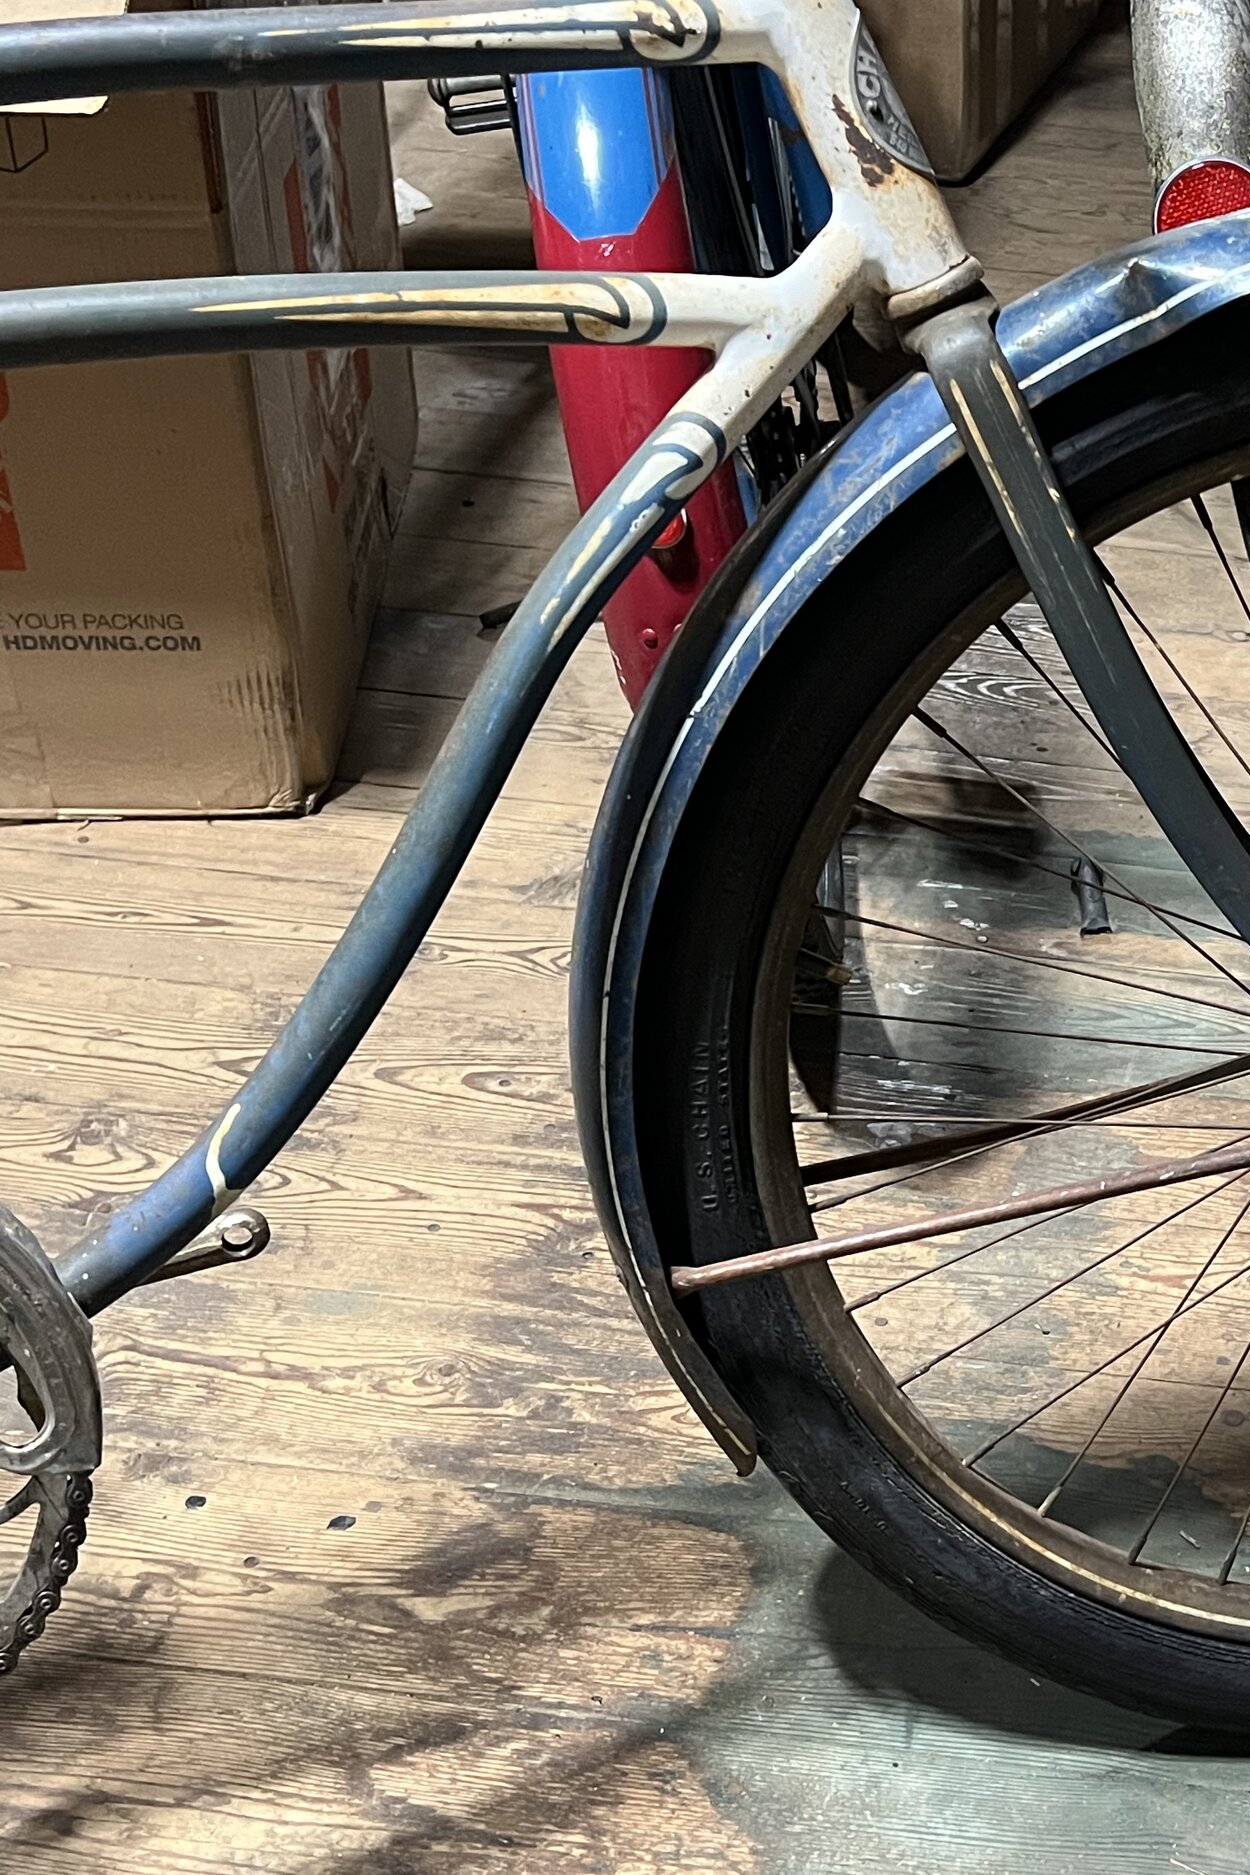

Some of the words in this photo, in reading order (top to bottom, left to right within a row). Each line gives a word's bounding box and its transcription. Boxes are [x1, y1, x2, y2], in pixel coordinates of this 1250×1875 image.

[7, 612, 77, 630] YOUR
[83, 613, 185, 630] PACKING
[2, 634, 203, 652] HDMOVING.COM
[690, 1042, 711, 1138] CHAIN
